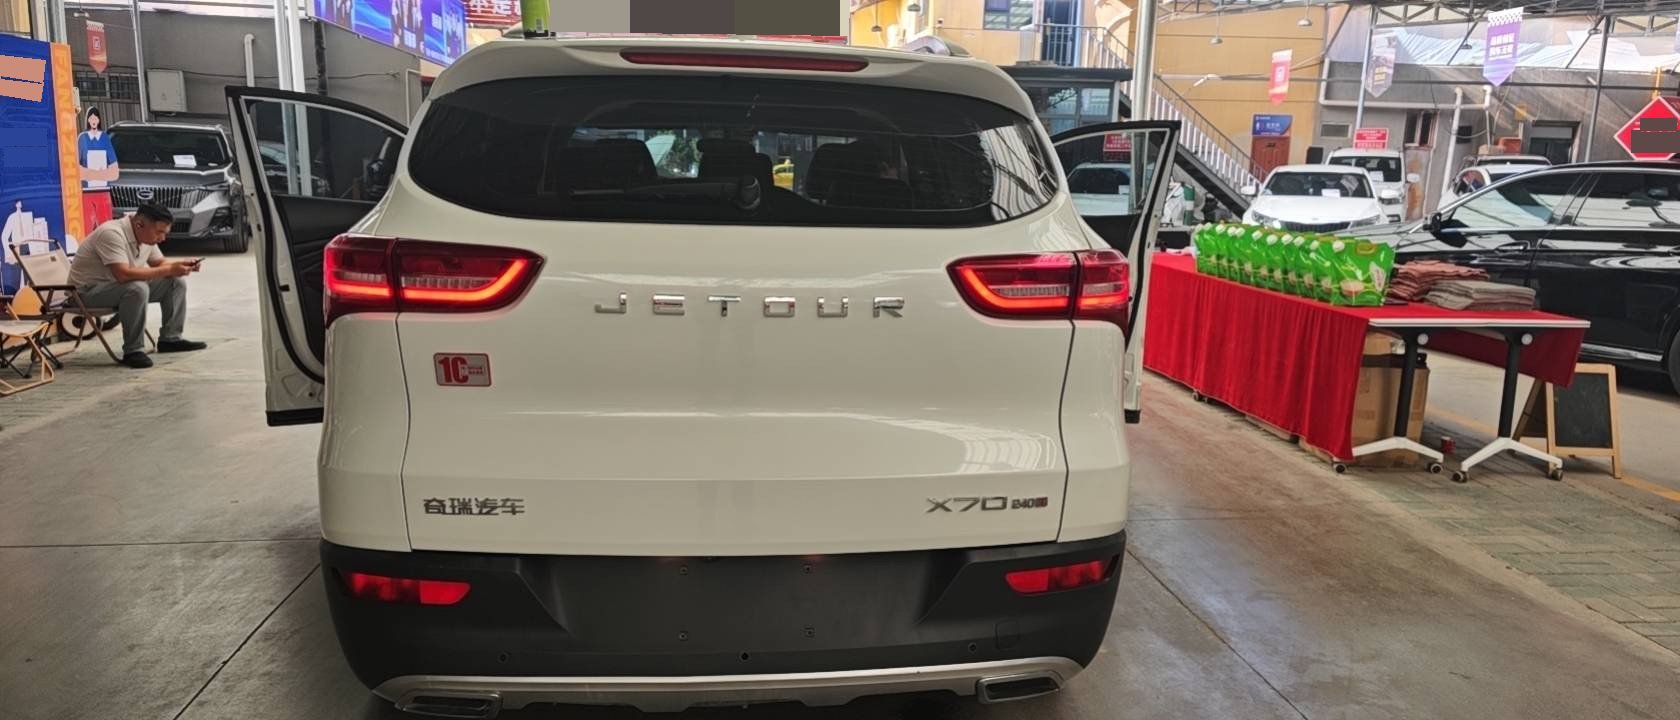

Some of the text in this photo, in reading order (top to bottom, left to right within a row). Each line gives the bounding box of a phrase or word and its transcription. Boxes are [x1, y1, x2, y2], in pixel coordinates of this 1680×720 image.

[594, 292, 905, 318] JETOUR
[423, 497, 525, 516] 奇瑞汽车
[925, 496, 1008, 513] X70
